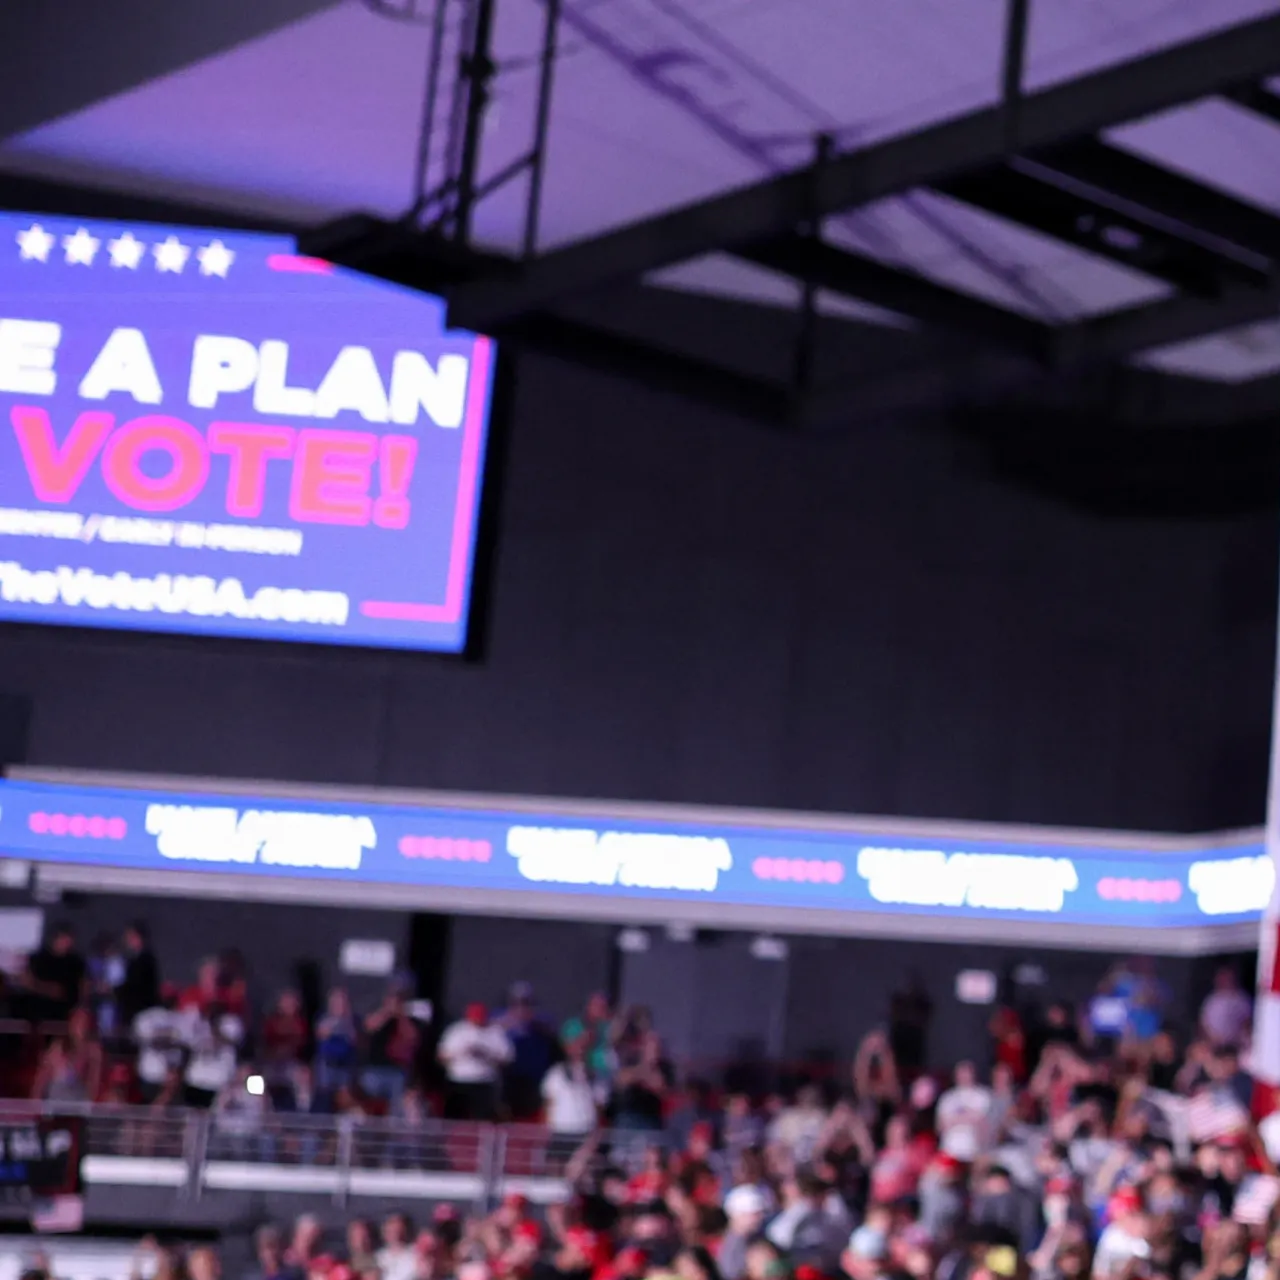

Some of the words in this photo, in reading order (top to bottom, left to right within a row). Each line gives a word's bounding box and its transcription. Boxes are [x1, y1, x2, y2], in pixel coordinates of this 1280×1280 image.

[0, 319, 61, 395] E
[79, 327, 164, 405] A
[188, 335, 468, 428] PLAN
[10, 405, 418, 529] VOTE!
